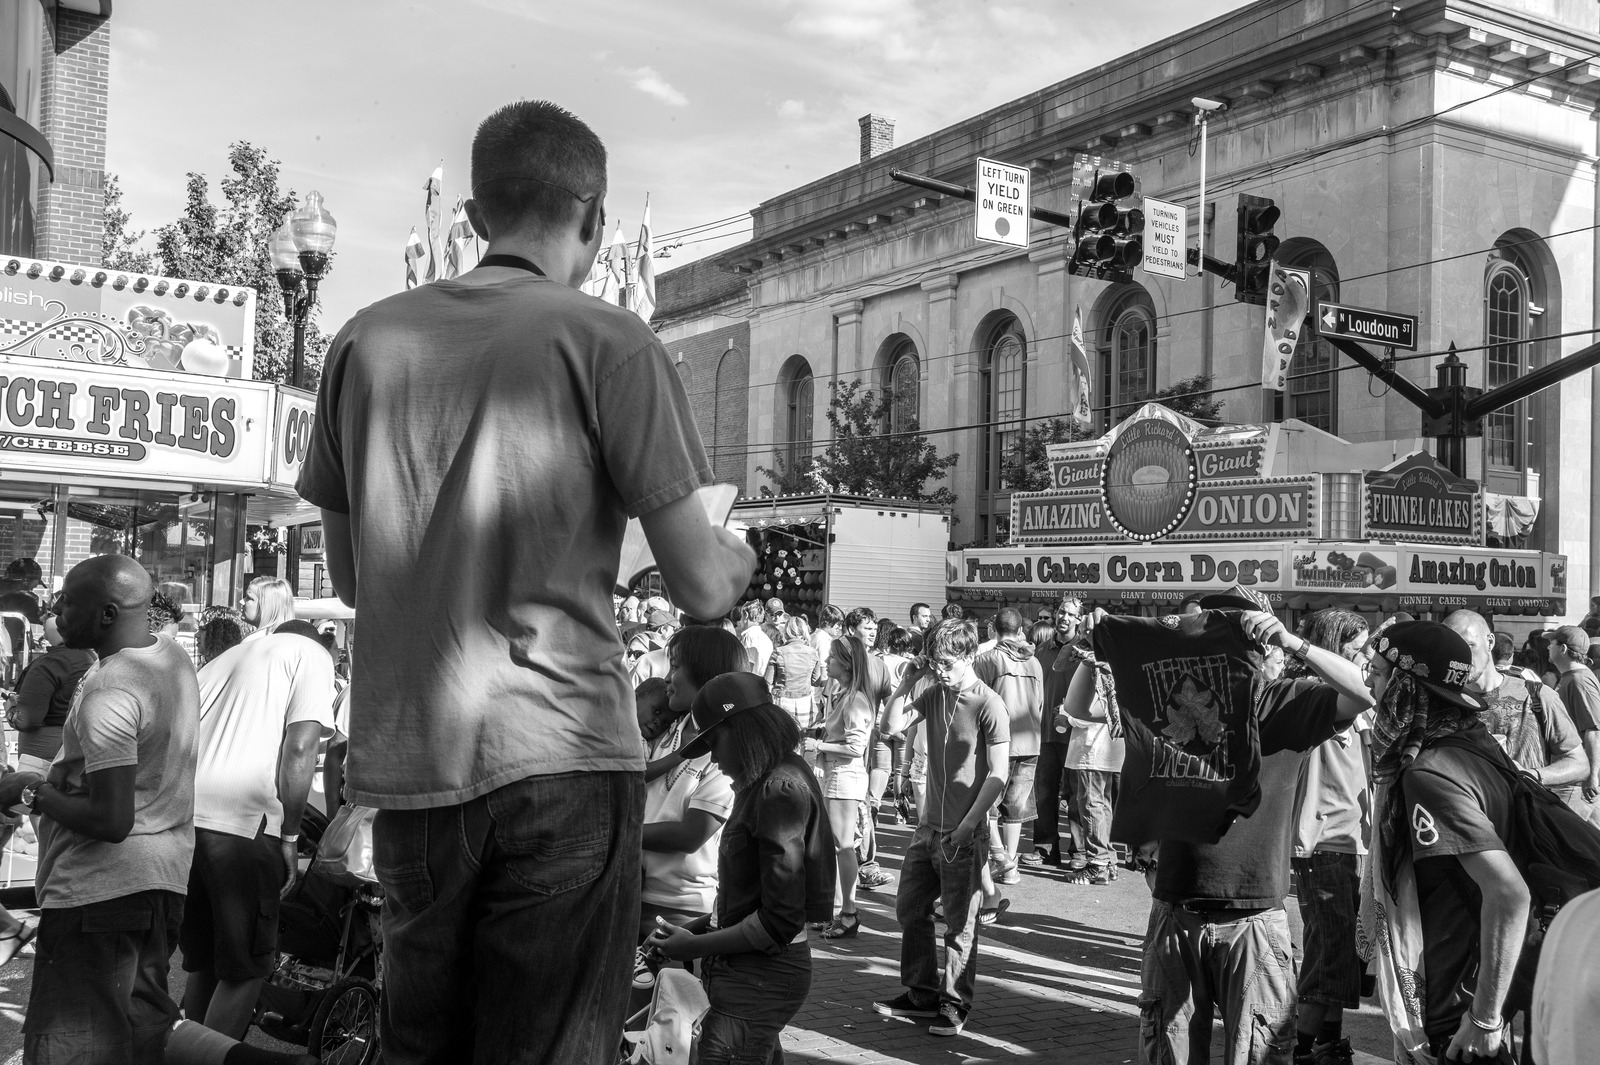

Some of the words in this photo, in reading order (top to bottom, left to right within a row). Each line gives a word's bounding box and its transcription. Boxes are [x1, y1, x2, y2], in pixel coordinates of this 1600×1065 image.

[982, 165, 1002, 179] LEFT
[1004, 170, 1025, 184] TURN
[987, 182, 1020, 200] YIELD
[982, 198, 994, 210] ON
[997, 202, 1024, 216] GREEN
[1153, 208, 1178, 221] TURNING
[1151, 219, 1180, 233] VEHICLES
[1154, 232, 1175, 245] MUST
[1152, 245, 1169, 257] YIELD
[1170, 247, 1179, 258] TO
[1145, 255, 1184, 271] PEDESTRIANS
[0, 287, 44, 307] lish
[1339, 312, 1345, 323] N
[1348, 314, 1399, 339] Loudoun
[1402, 323, 1411, 334] ST
[0, 376, 77, 431] CH
[87, 385, 236, 458] FRIES
[285, 407, 316, 464] CO
[1120, 426, 1141, 449] Little
[1144, 422, 1180, 445] Richard's
[1202, 450, 1254, 476] Giant
[1058, 462, 1100, 487] Giant
[1022, 502, 1101, 531] AMAZING
[1197, 492, 1302, 525] ONION
[1372, 493, 1426, 526] FUNNEL
[1428, 497, 1470, 530] CAKES
[966, 556, 1033, 583] Funnel
[1036, 556, 1101, 583] Cakes
[1106, 554, 1183, 583] Corn
[1190, 553, 1280, 585] Dogs
[1296, 565, 1364, 582] Twinkies
[1408, 553, 1486, 591] Amazing
[1489, 557, 1537, 589] Onion
[985, 589, 1003, 597] DOGS
[1031, 590, 1060, 598] FUNNEL
[1063, 590, 1088, 599] CAKES
[1120, 591, 1146, 599] GIANT
[1151, 591, 1185, 600] ONIONS
[1398, 595, 1433, 605] FUNNEL
[1438, 596, 1467, 606] CAKES
[1486, 597, 1512, 607] GIANT
[1518, 598, 1550, 608] ONIONS
